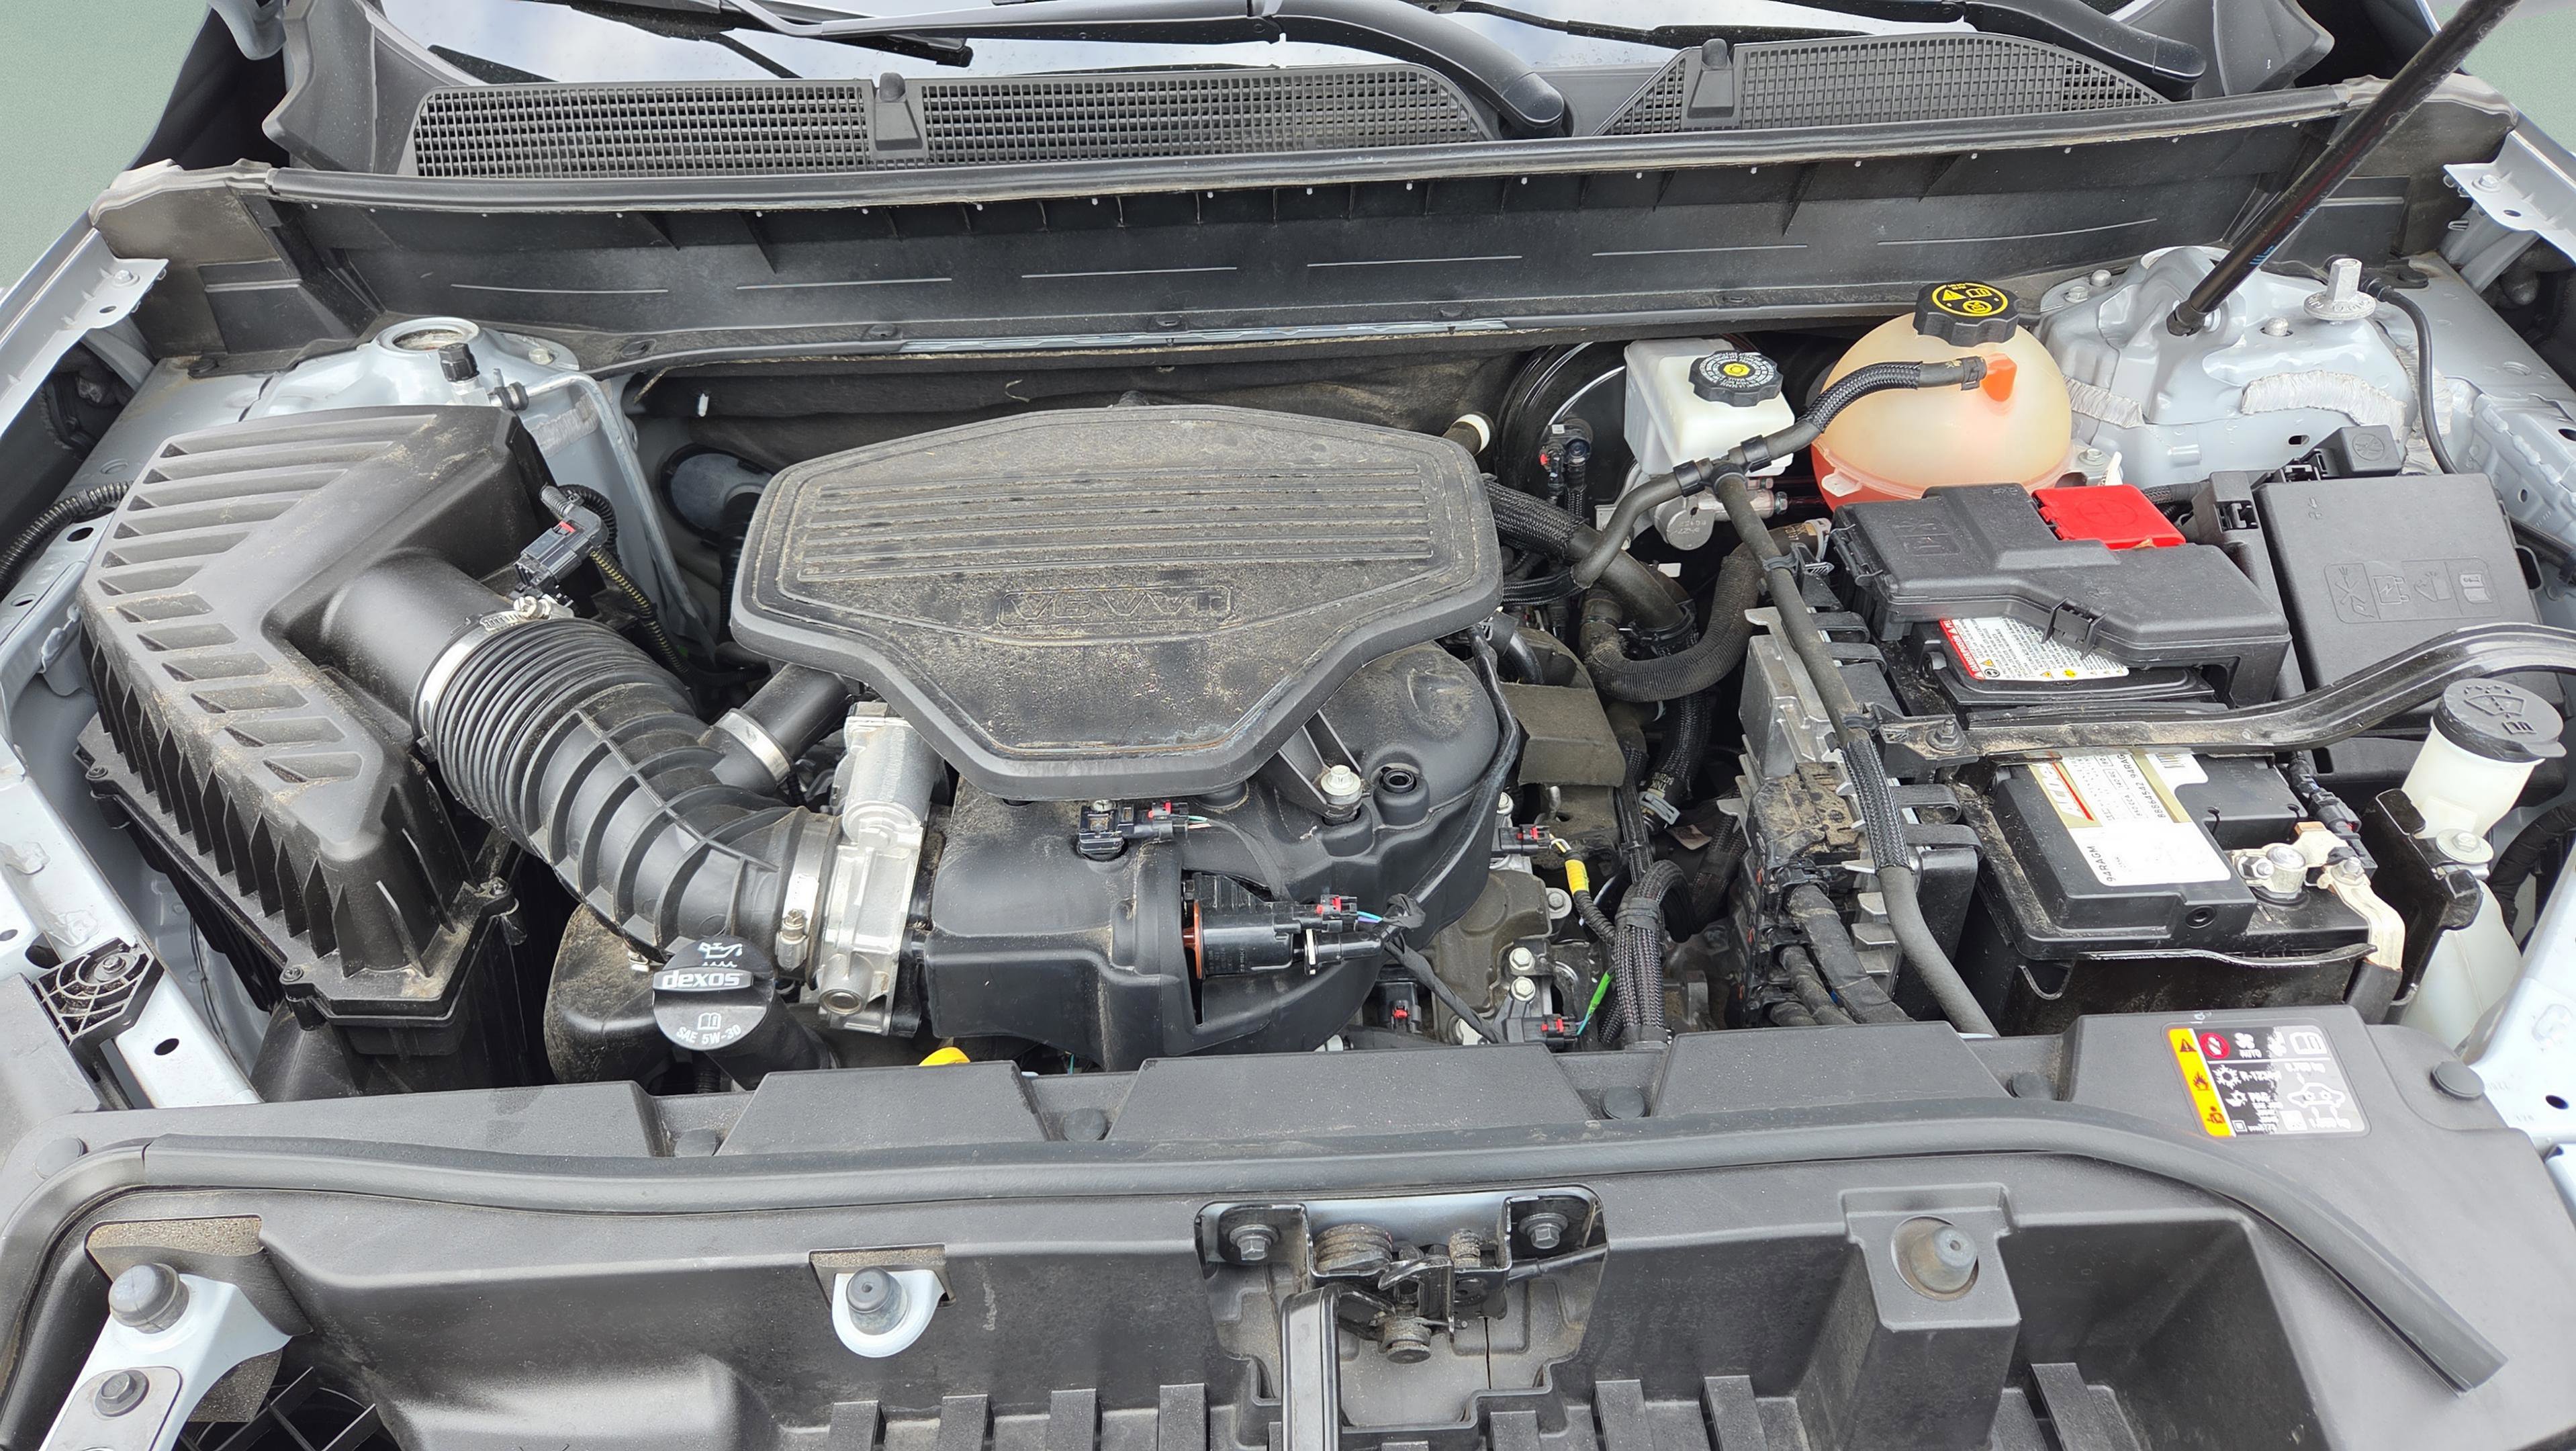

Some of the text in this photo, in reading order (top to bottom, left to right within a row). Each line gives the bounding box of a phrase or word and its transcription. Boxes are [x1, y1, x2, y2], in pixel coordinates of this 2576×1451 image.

[2086, 844, 2117, 883] 94RAGM
[662, 970, 743, 988] dexos
[676, 1024, 742, 1045] SAE 5W-30
